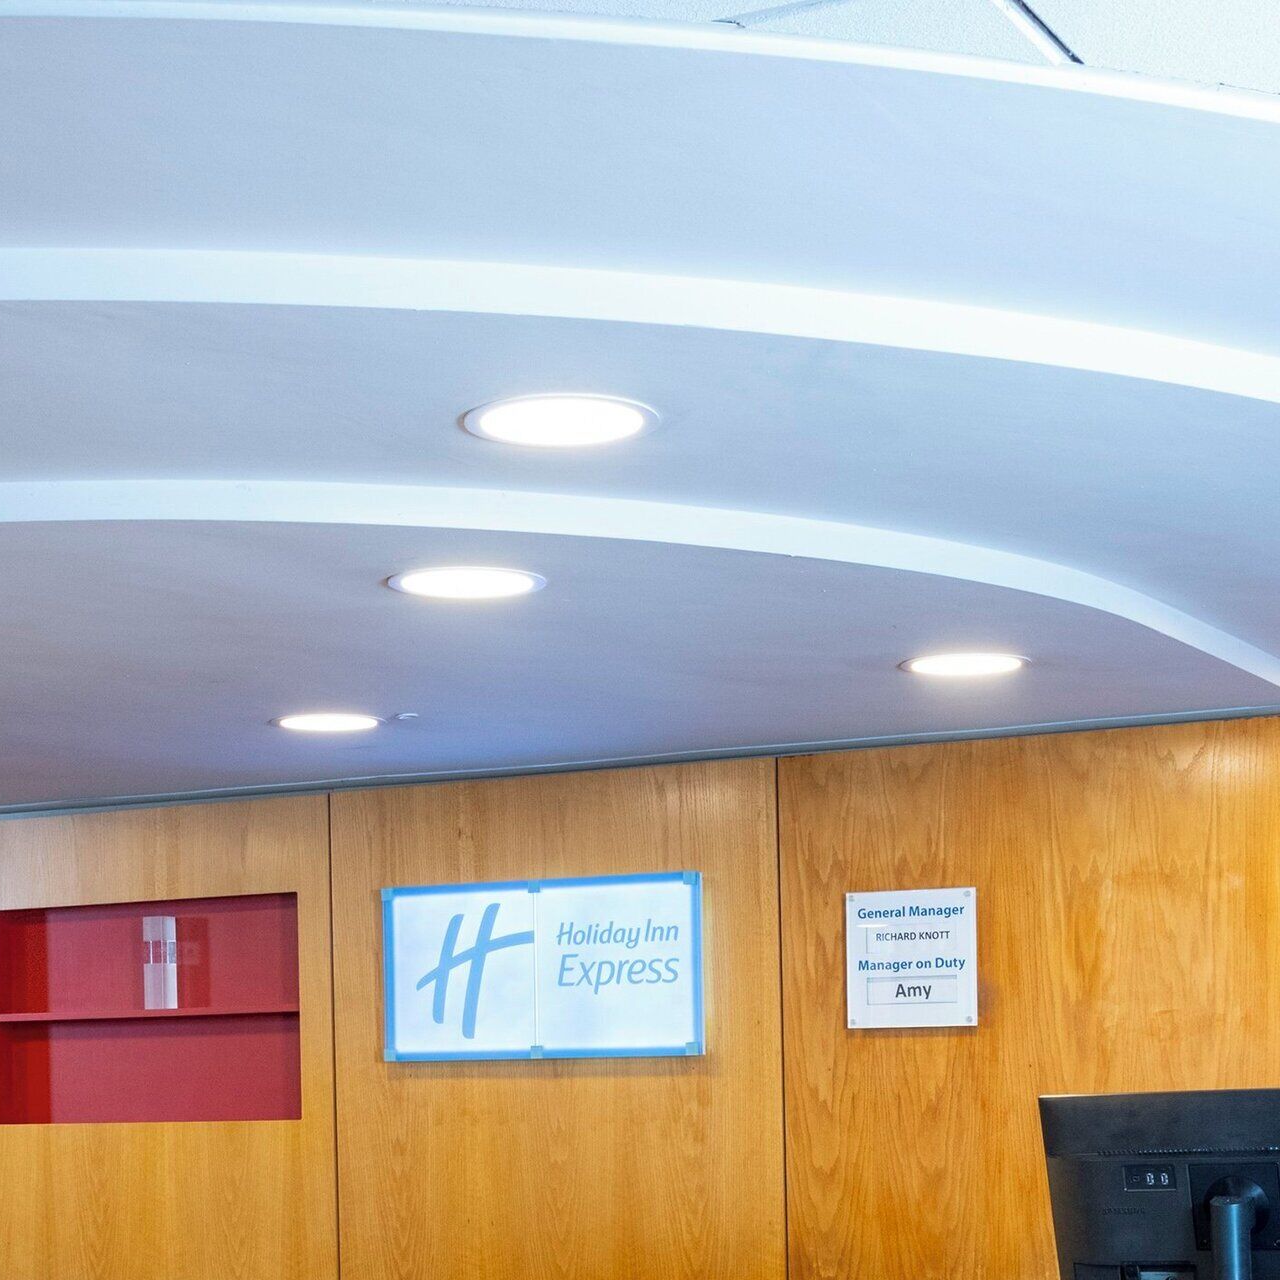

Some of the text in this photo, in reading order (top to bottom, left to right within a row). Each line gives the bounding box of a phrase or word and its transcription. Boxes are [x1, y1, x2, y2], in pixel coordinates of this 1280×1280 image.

[857, 905, 965, 919] General Manager
[556, 918, 679, 949] Holiday Inn
[876, 930, 950, 942] RICHARD KNOTT
[858, 957, 966, 972] Manager on Duty
[557, 953, 680, 995] Express
[895, 983, 932, 999] Amy
